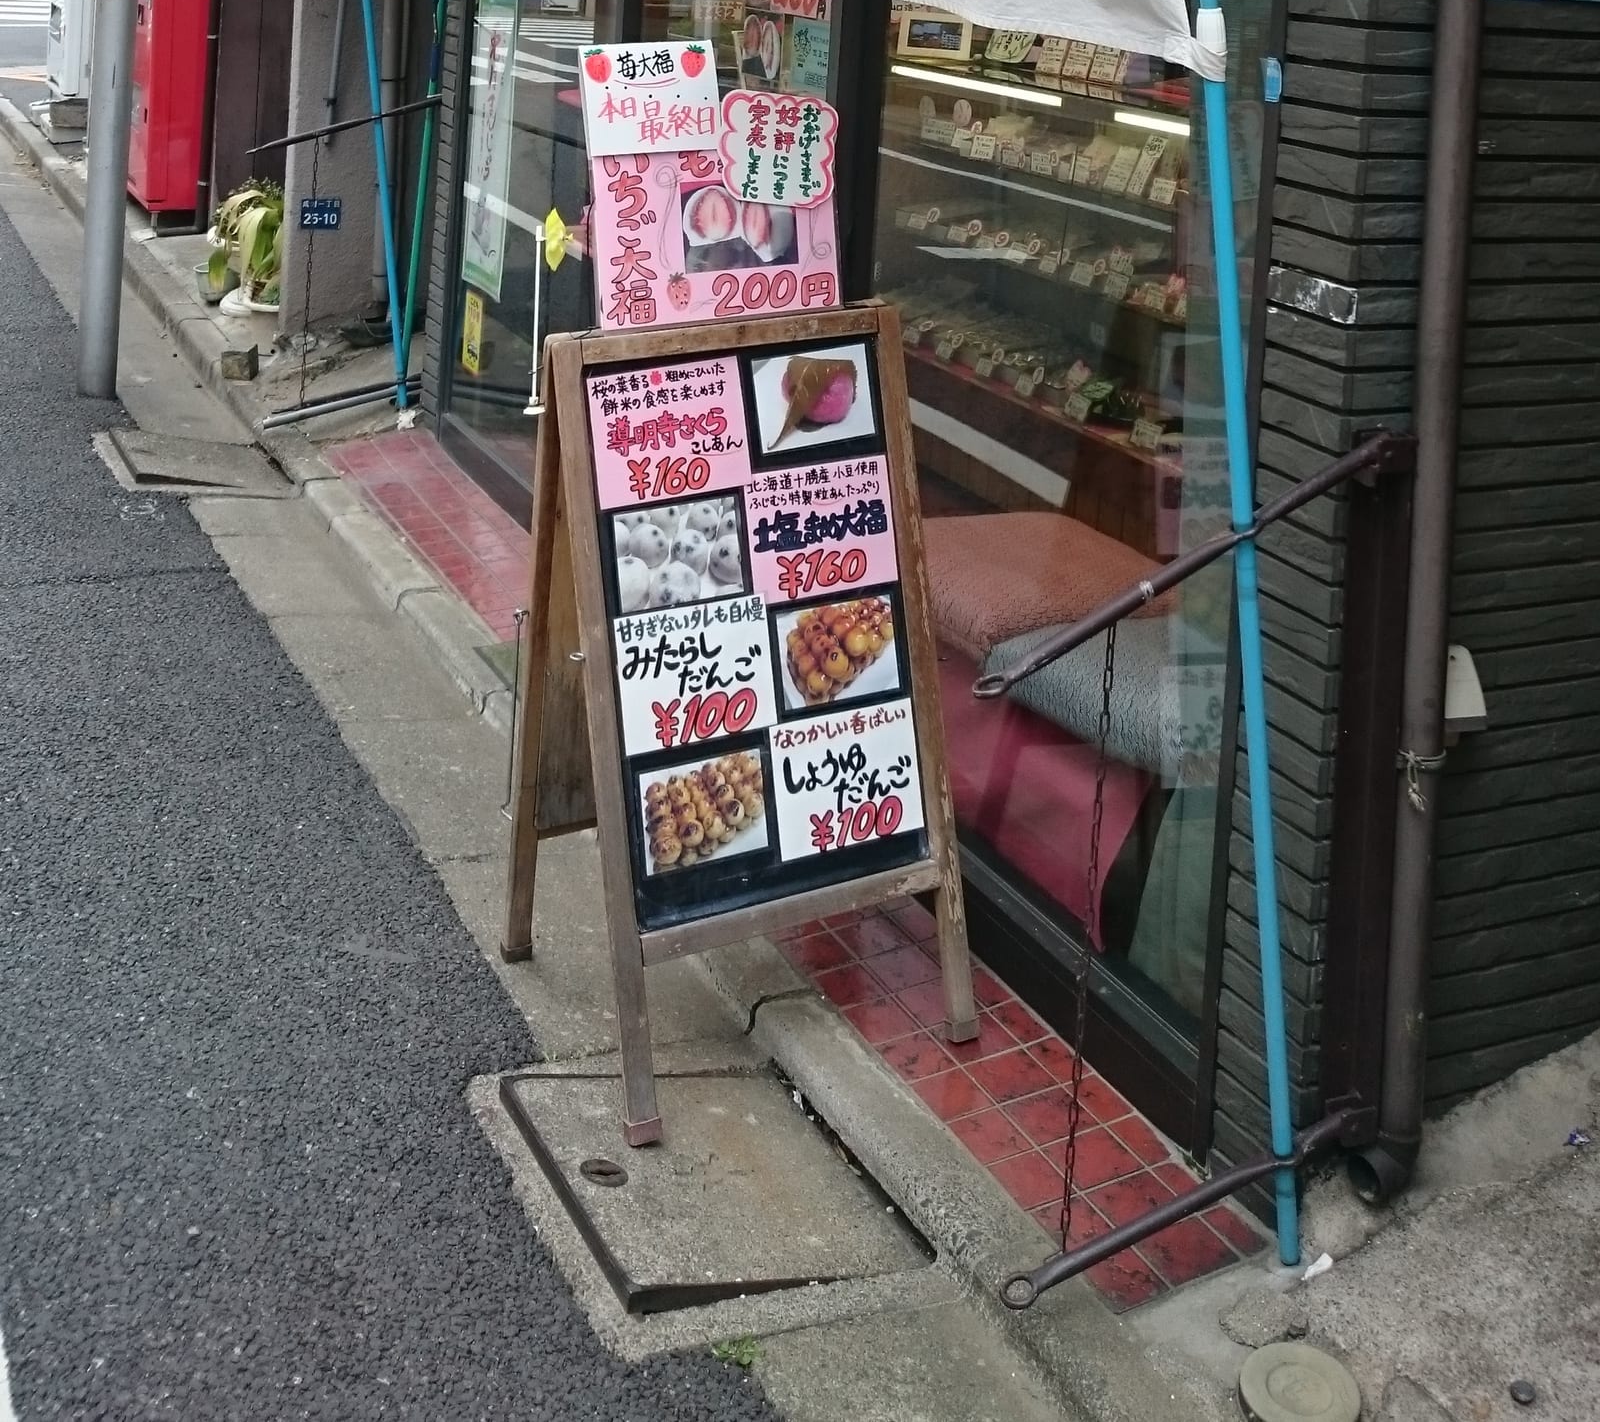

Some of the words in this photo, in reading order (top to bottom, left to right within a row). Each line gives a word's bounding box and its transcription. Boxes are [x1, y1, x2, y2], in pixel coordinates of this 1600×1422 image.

[617, 49, 674, 80] 苺大福
[742, 100, 771, 199] 完売しました
[773, 105, 802, 200] 好評につき
[799, 104, 821, 197] おかげさまで
[304, 213, 337, 225] 25-10
[712, 269, 836, 317] 200円
[591, 374, 649, 399] 桜の葉香る
[690, 435, 743, 455] こしあん
[627, 456, 711, 500] ¥160
[753, 499, 888, 553] 塩まめ大福
[776, 548, 867, 599] ¥160
[616, 596, 765, 644] 甘すぎないタレも自慢
[622, 632, 722, 681] みたらし
[678, 644, 762, 697] だんご
[651, 687, 758, 748] ¥100
[773, 707, 906, 749] なつかしい香ばしい
[783, 743, 867, 795] しょうゆ
[833, 755, 912, 813] だんご
[810, 795, 903, 853] ¥100
